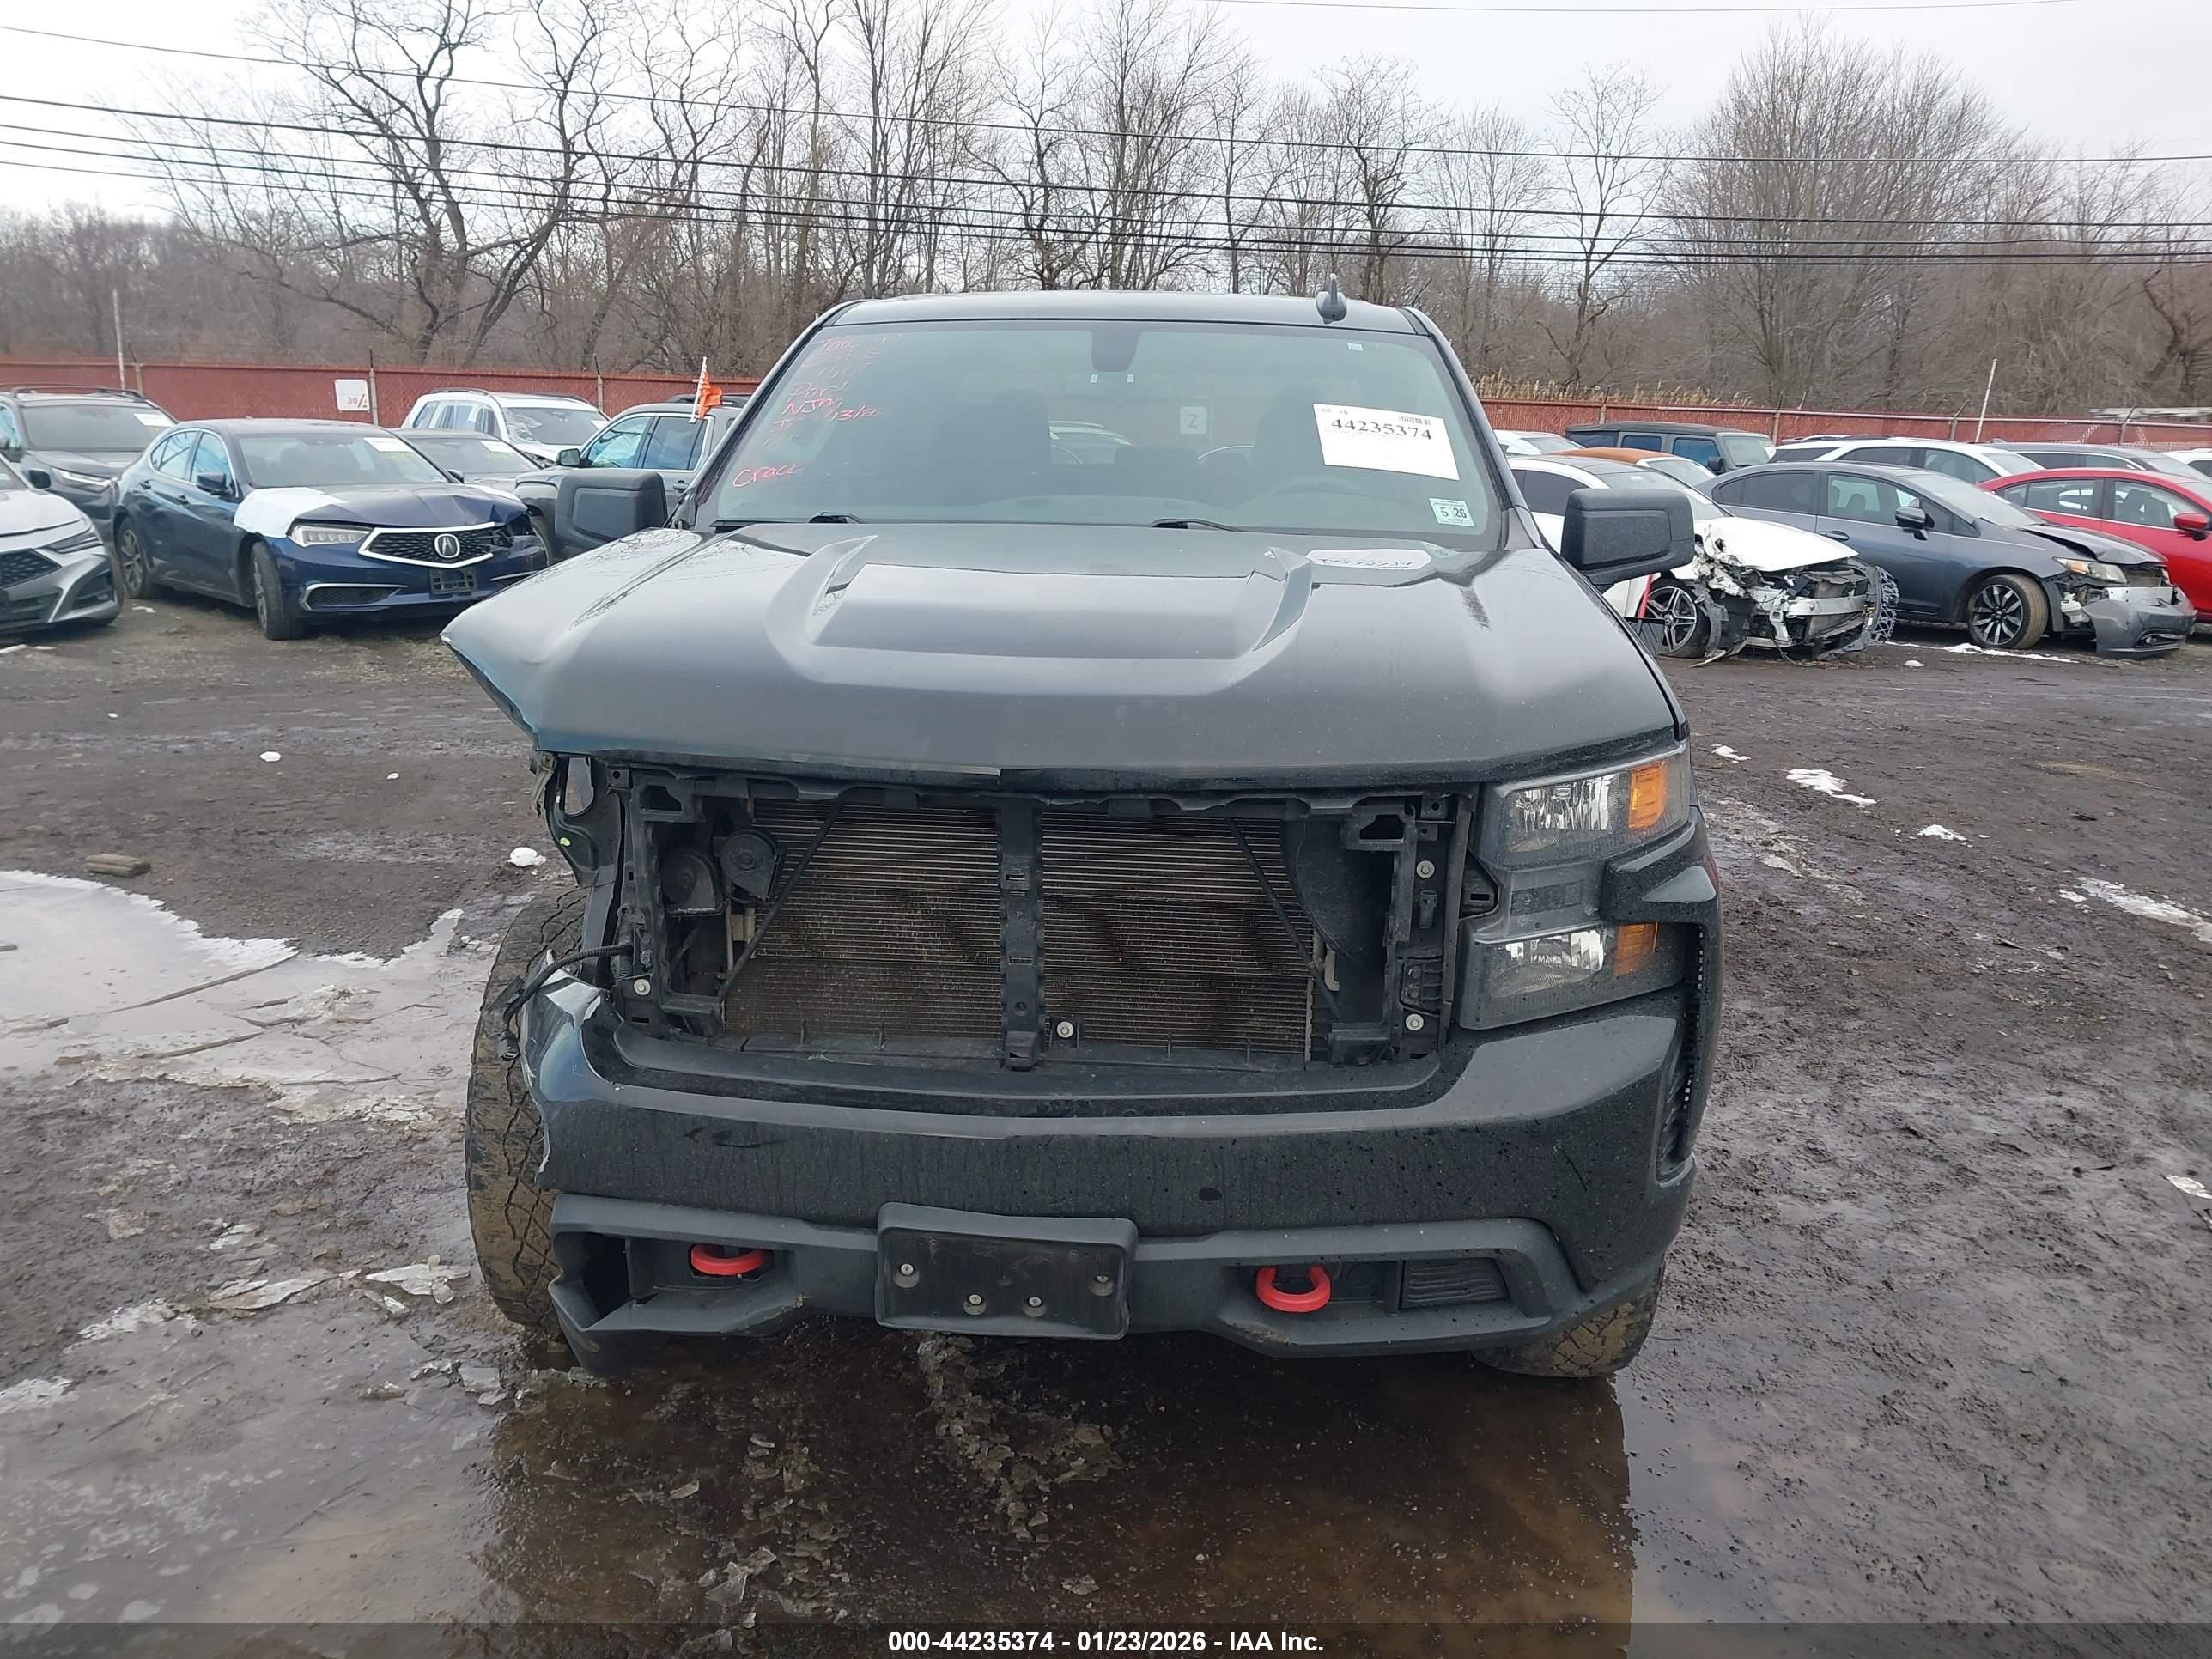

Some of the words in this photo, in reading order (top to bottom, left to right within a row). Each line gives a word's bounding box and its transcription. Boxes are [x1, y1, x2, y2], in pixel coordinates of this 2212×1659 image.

[1331, 418, 1432, 440] 44235374
[1439, 507, 1449, 517] 5
[1453, 507, 1468, 519] 26
